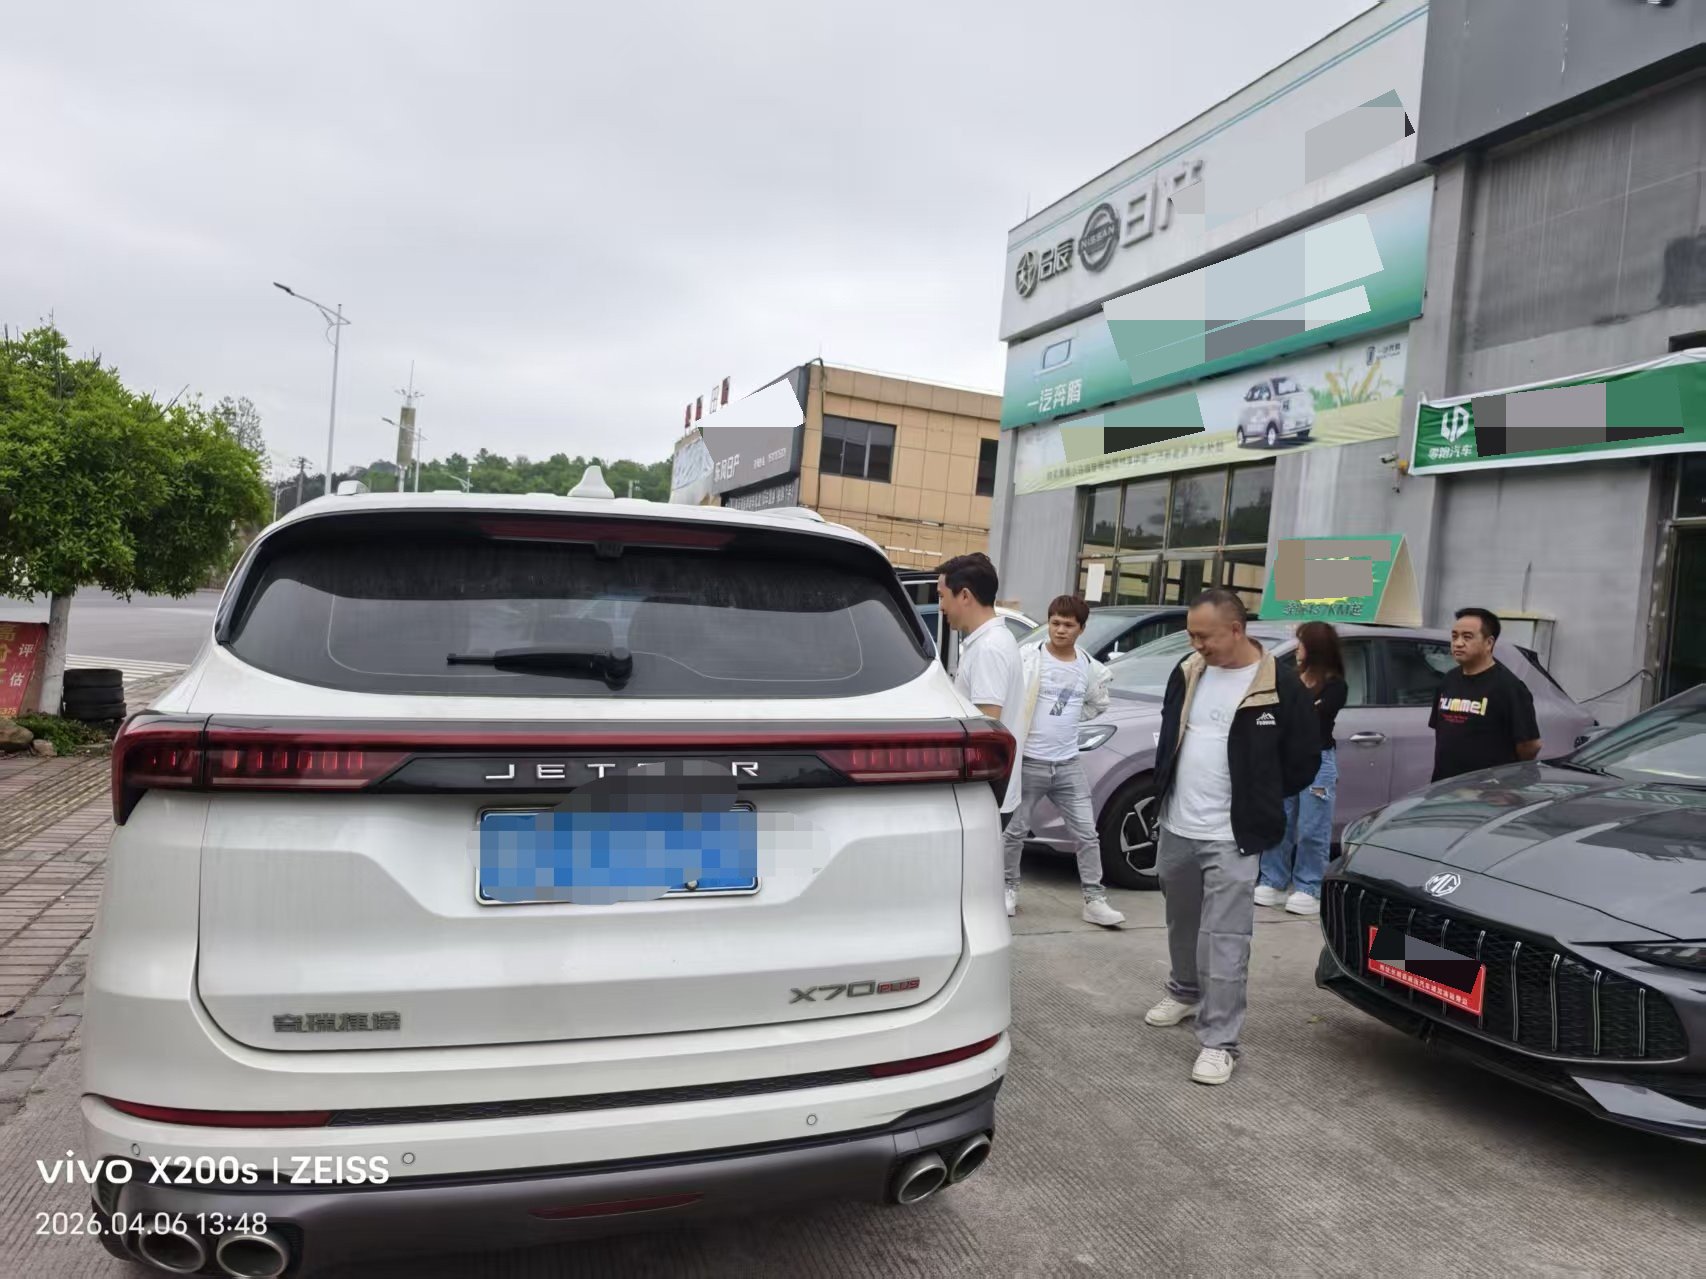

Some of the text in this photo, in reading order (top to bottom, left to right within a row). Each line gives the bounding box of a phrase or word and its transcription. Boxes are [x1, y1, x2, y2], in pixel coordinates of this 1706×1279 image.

[1080, 223, 1116, 249] NISSAN
[486, 761, 759, 780] JETR
[1427, 873, 1460, 896] MG
[789, 980, 876, 1004] X70
